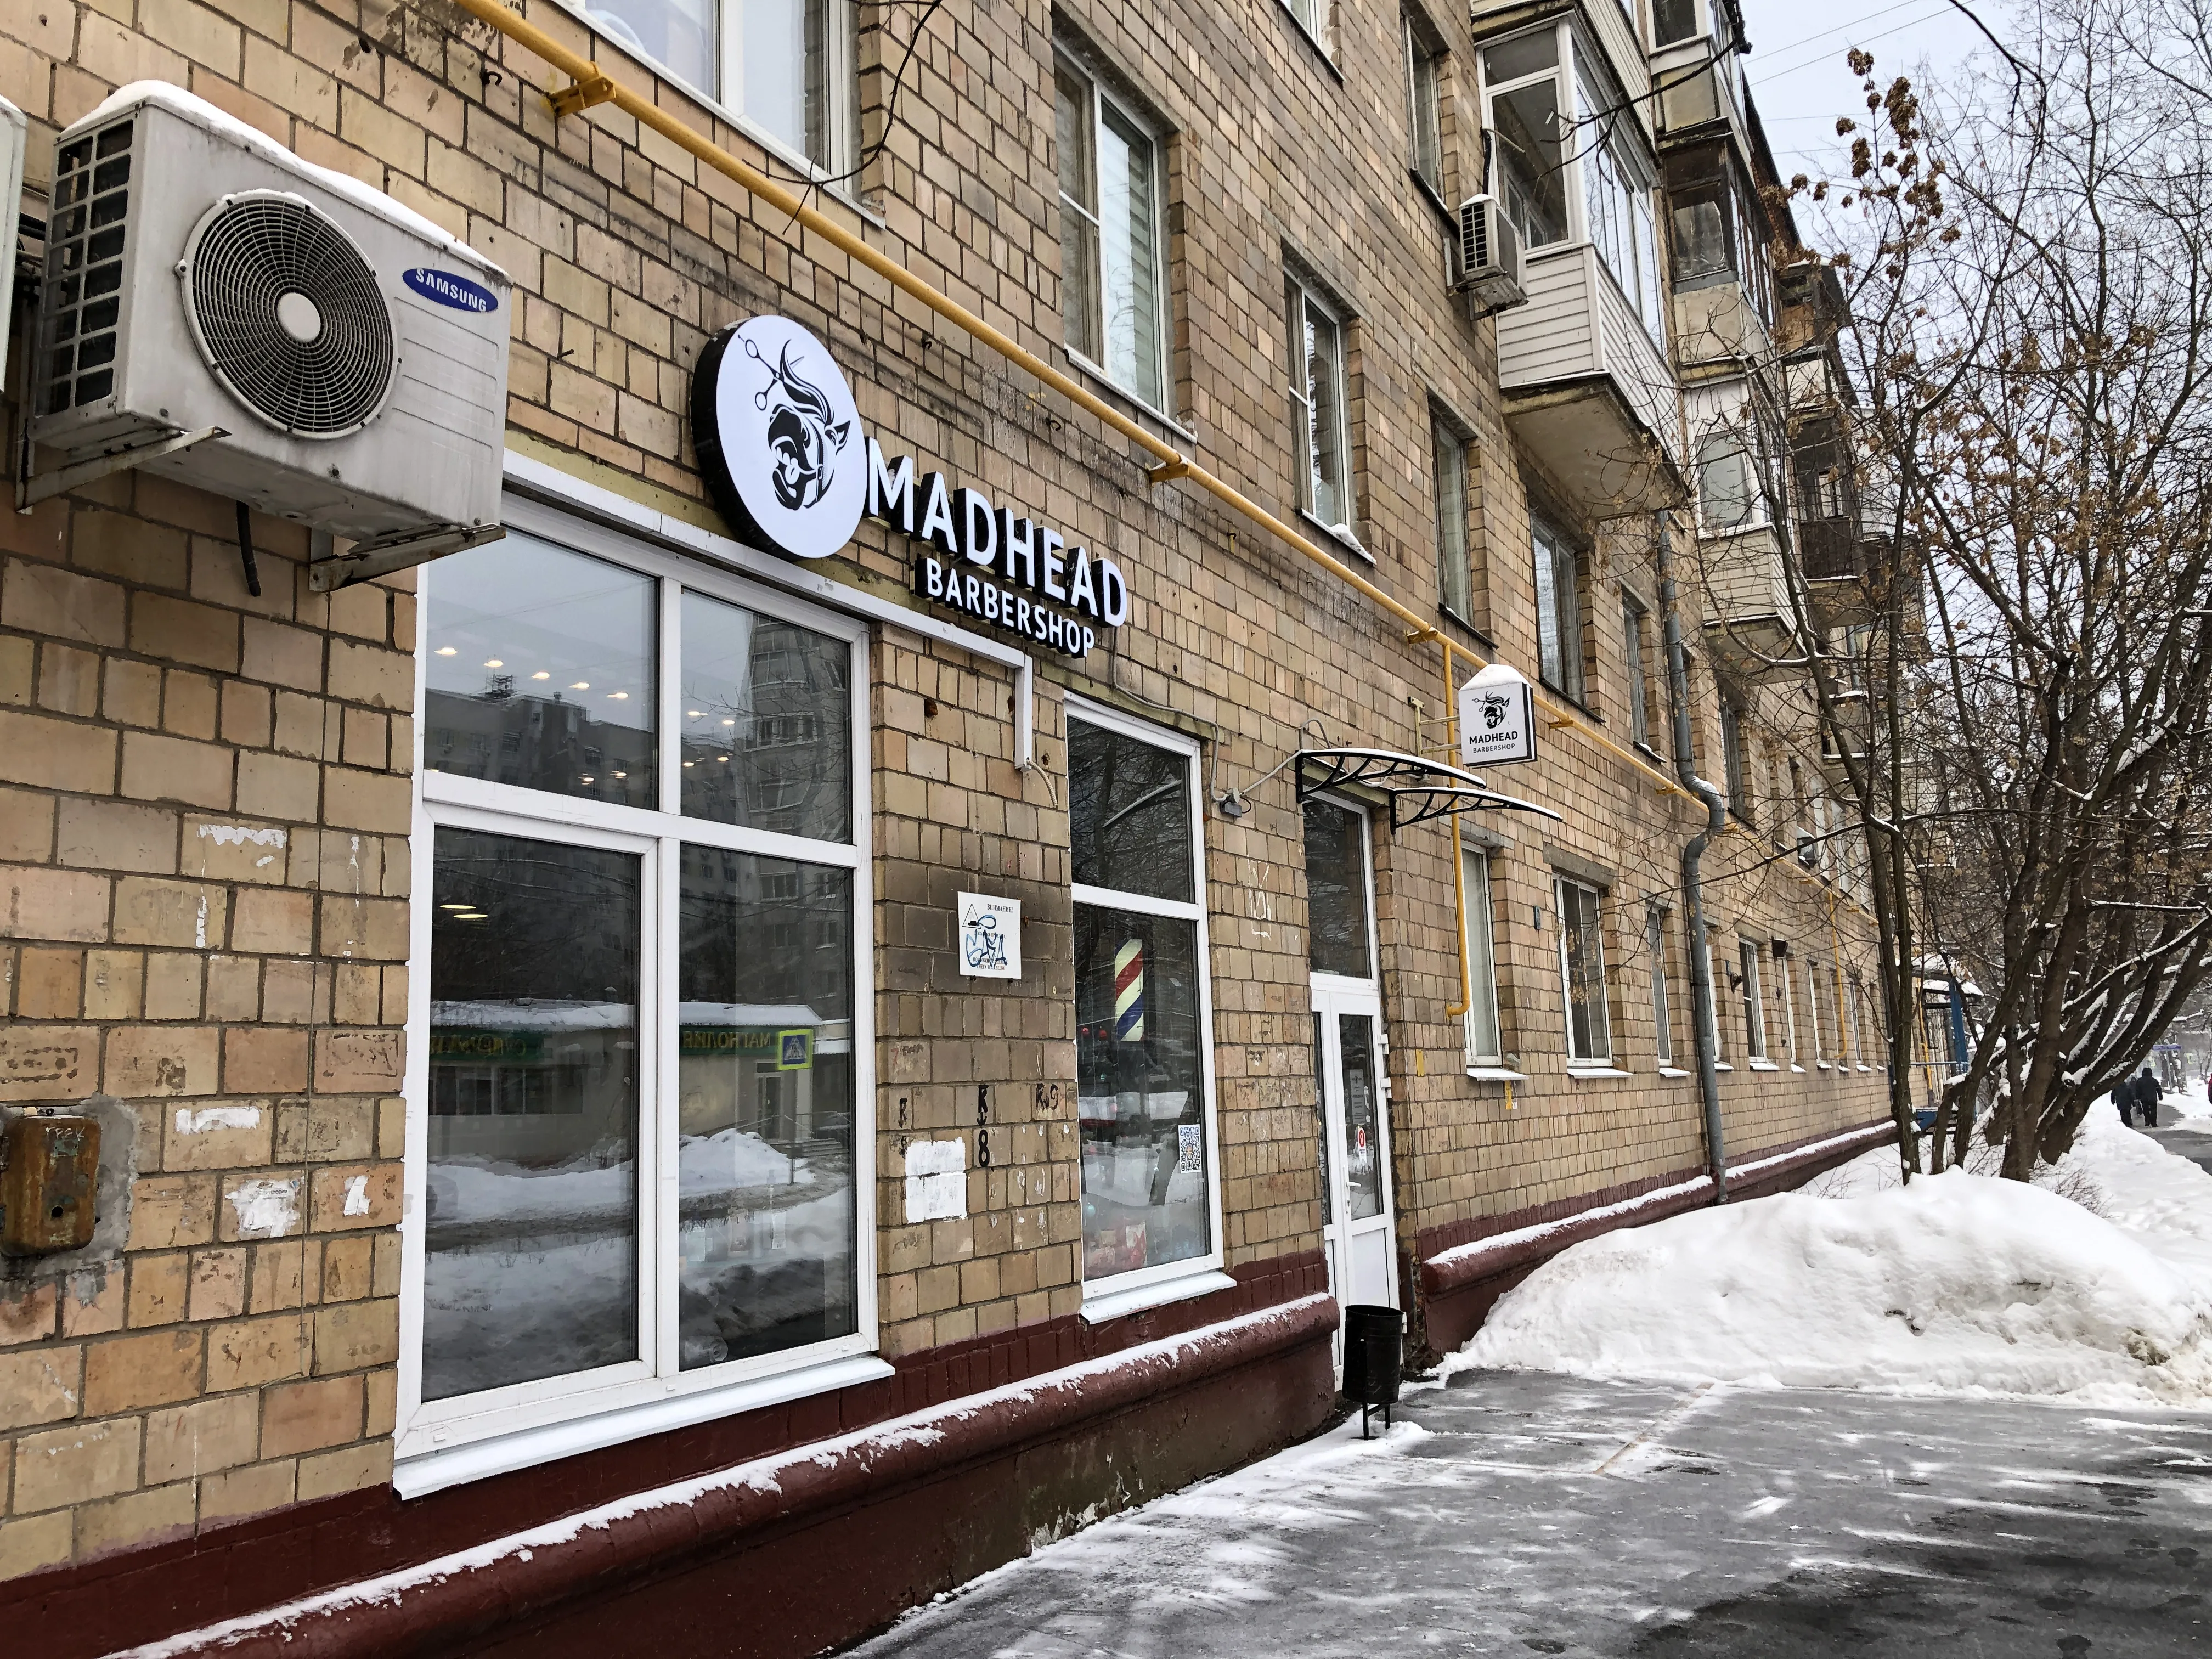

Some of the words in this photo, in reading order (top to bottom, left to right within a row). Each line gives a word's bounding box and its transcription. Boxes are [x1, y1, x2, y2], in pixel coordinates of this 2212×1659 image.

[416, 268, 486, 312] SAMSUNG
[869, 437, 1127, 627] MADHEAD
[927, 557, 1094, 657] BARBERSHOP
[1469, 731, 1518, 745] MADHEAD
[1473, 743, 1515, 754] BARBERSHOP
[987, 904, 1013, 913] ВНИМАНИЕ!
